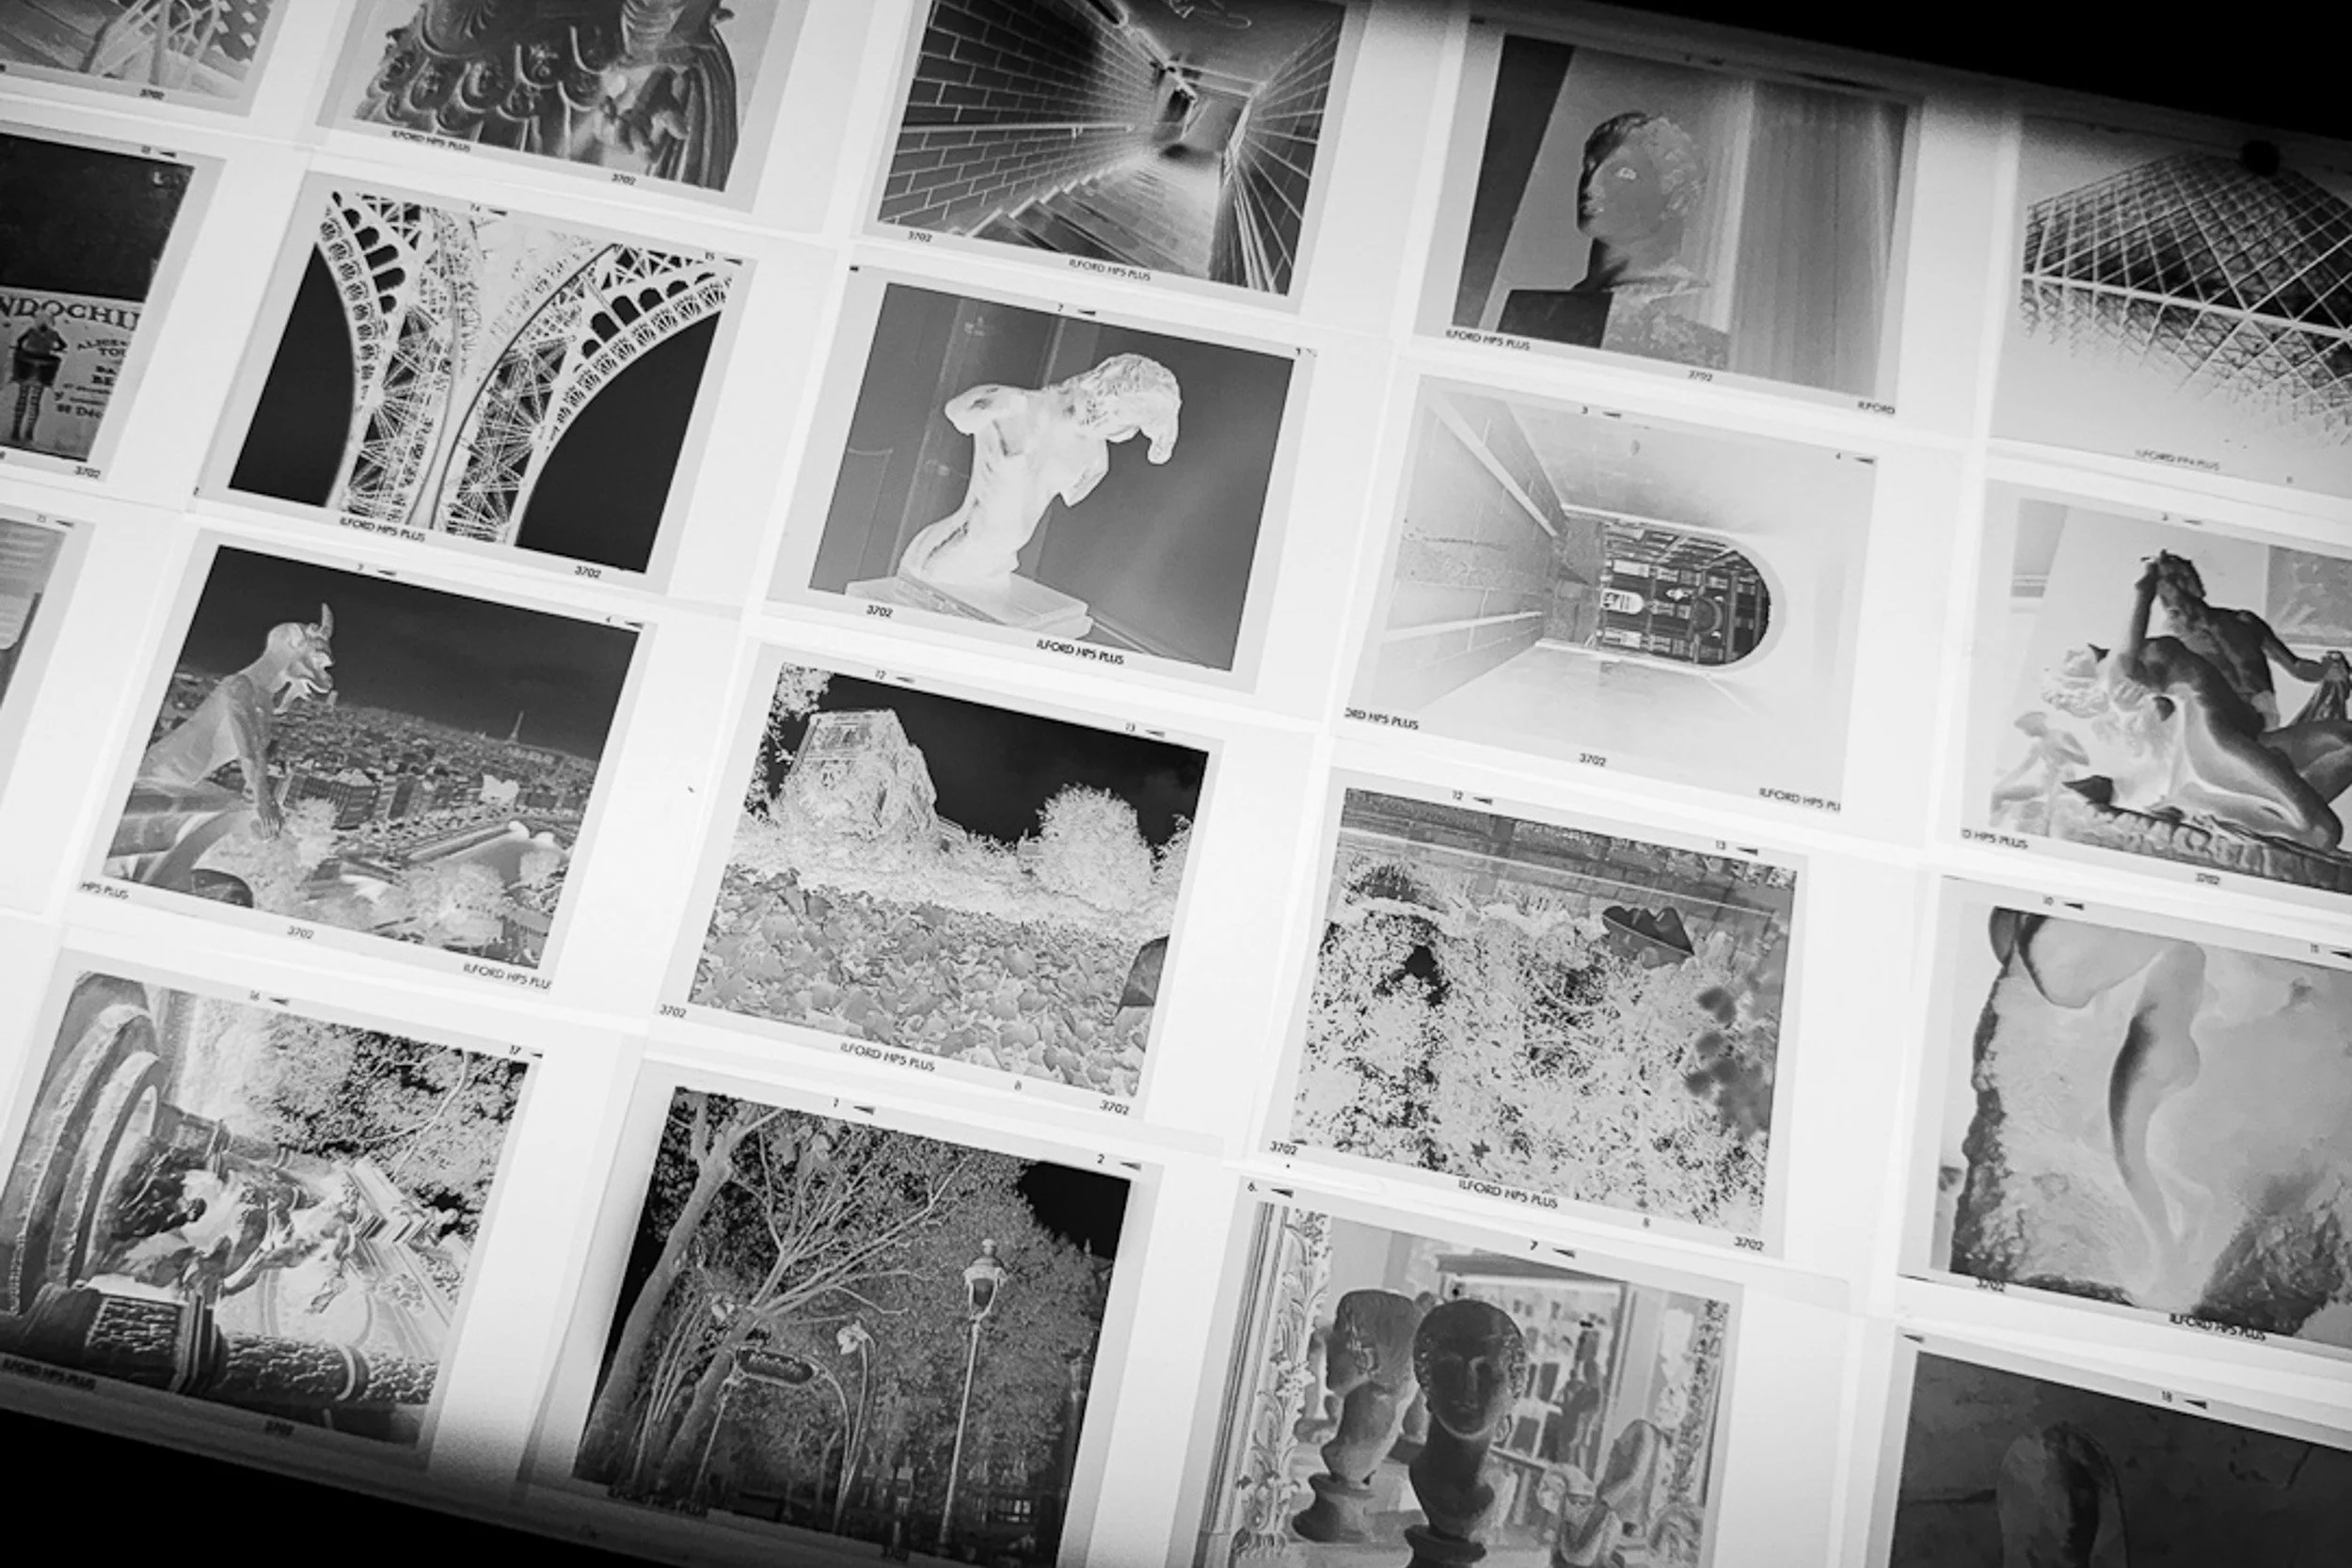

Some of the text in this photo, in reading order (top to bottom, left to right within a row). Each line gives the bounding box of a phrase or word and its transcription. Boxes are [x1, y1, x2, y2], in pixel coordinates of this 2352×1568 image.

[866, 604, 894, 619] 3702
[1578, 752, 1608, 768] 3702
[660, 1003, 688, 1019] 3702
[839, 1041, 882, 1060] ILFORD
[909, 1056, 937, 1072] PLUS
[1099, 1098, 1131, 1117] 3702
[1269, 1140, 1299, 1156] 3702
[1457, 1179, 1502, 1197] ILFORD
[1530, 1194, 1559, 1210] PLUS
[1734, 1235, 1766, 1253] 3702
